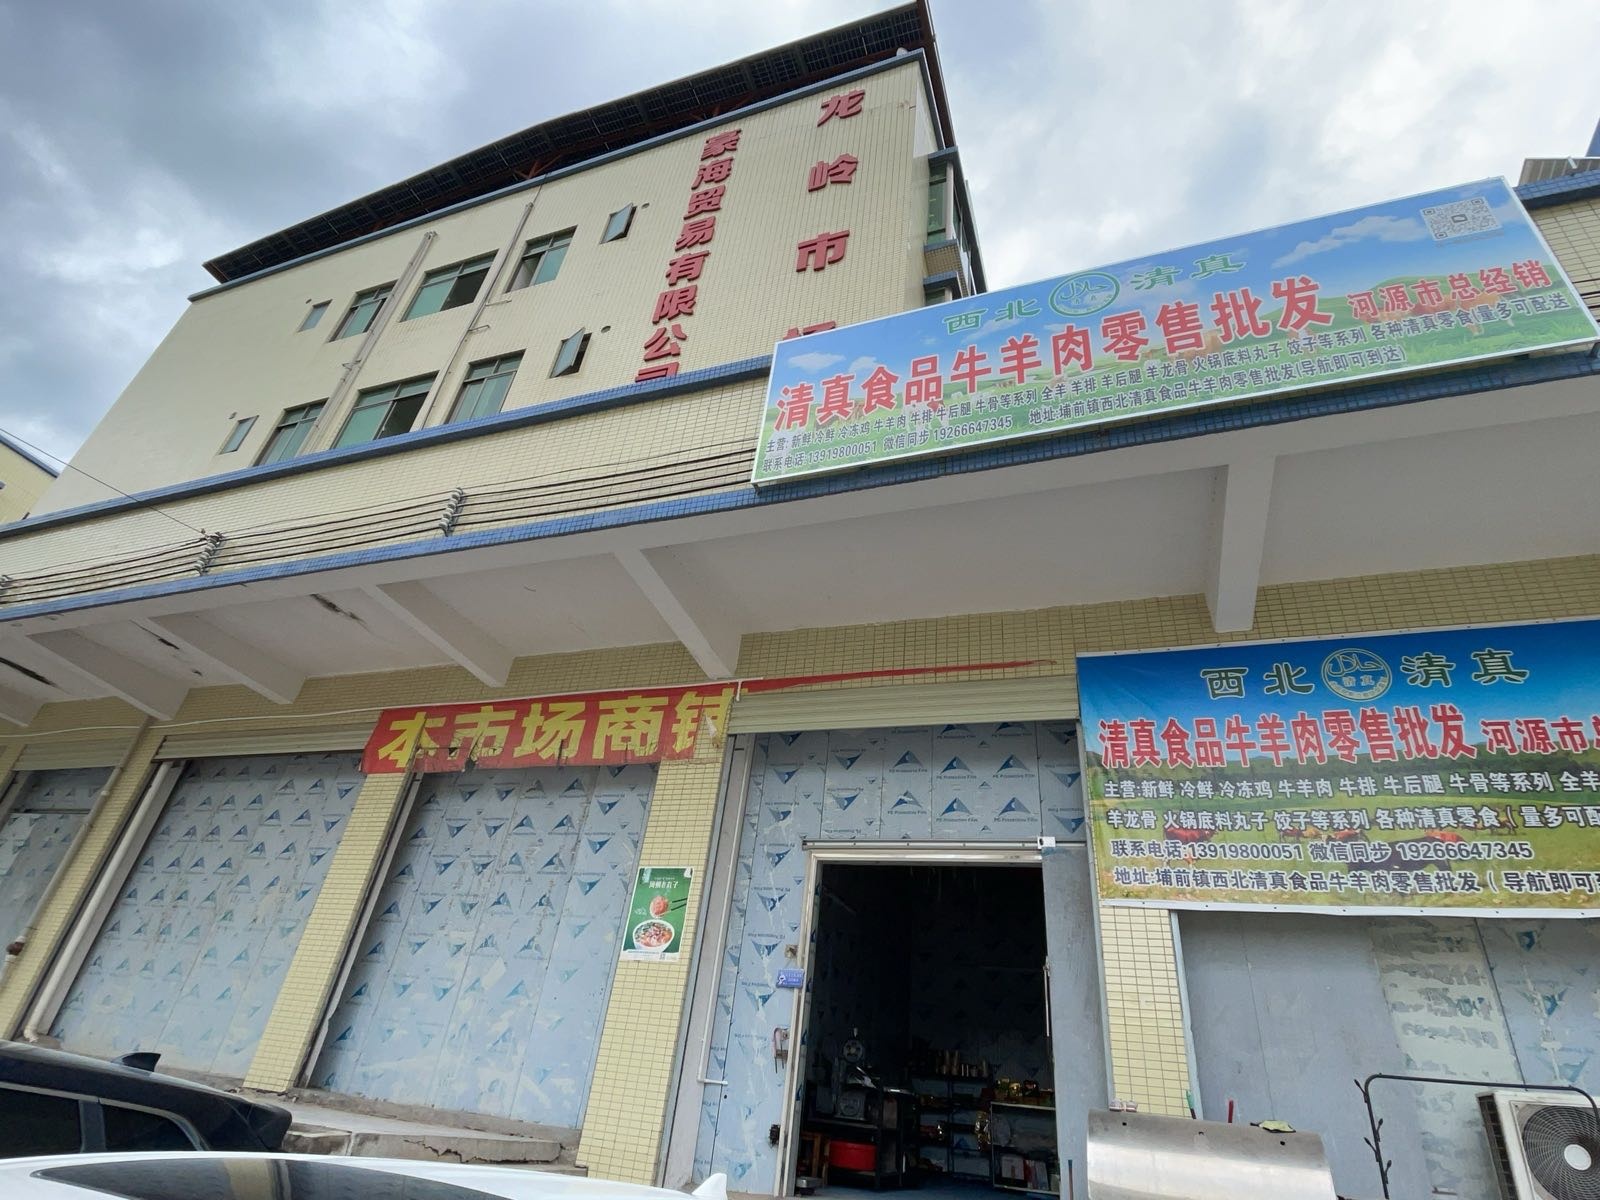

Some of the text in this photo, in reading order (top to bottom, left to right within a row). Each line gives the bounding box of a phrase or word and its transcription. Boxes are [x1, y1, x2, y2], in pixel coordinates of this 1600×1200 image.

[783, 89, 866, 341] 龙岭市
[943, 252, 1246, 334] 西北 清真
[774, 259, 1552, 431] 清真食品牛羊肉零售批发 河源市总经销
[815, 428, 835, 444] 冷鲜
[838, 422, 870, 439] 冷冻鸡
[874, 416, 906, 433] 牛羊肉
[911, 410, 933, 425] 牛排
[936, 399, 972, 421] 牛后腿
[975, 387, 1038, 414] 牛骨等系列
[1041, 383, 1067, 401] 全羊
[1071, 377, 1097, 396] 羊排
[1101, 368, 1142, 389] 羊后腿
[1146, 359, 1188, 381] 羊龙骨
[1193, 343, 1282, 373] 火锅底料丸子
[1287, 327, 1366, 355] 饺子等系列
[884, 432, 929, 452] 微信同步
[934, 416, 1012, 441] 19266647345
[1201, 648, 1530, 700] 西北 清真
[1097, 703, 1600, 769] 清真食品牛羊肉零售批发 河源市
[1179, 781, 1214, 799] 冷鲜
[1219, 780, 1273, 799] 冷冻鸡
[1278, 778, 1334, 798] 牛羊肉
[1339, 776, 1378, 796] 牛排
[1383, 774, 1445, 796] 牛后腿
[1450, 771, 1554, 794] 牛骨等系列
[1559, 770, 1600, 792] 全羊
[1107, 810, 1157, 830] 羊龙骨
[1163, 810, 1269, 831] 火锅底料丸子
[1274, 809, 1370, 831] 饺子等系列
[1111, 839, 1534, 863] 联系电话:13919800051 微信同步 19266647345
[1113, 867, 1600, 895] 地址:埔前镇西北清真食品牛羊肉零售批发（导航即可
